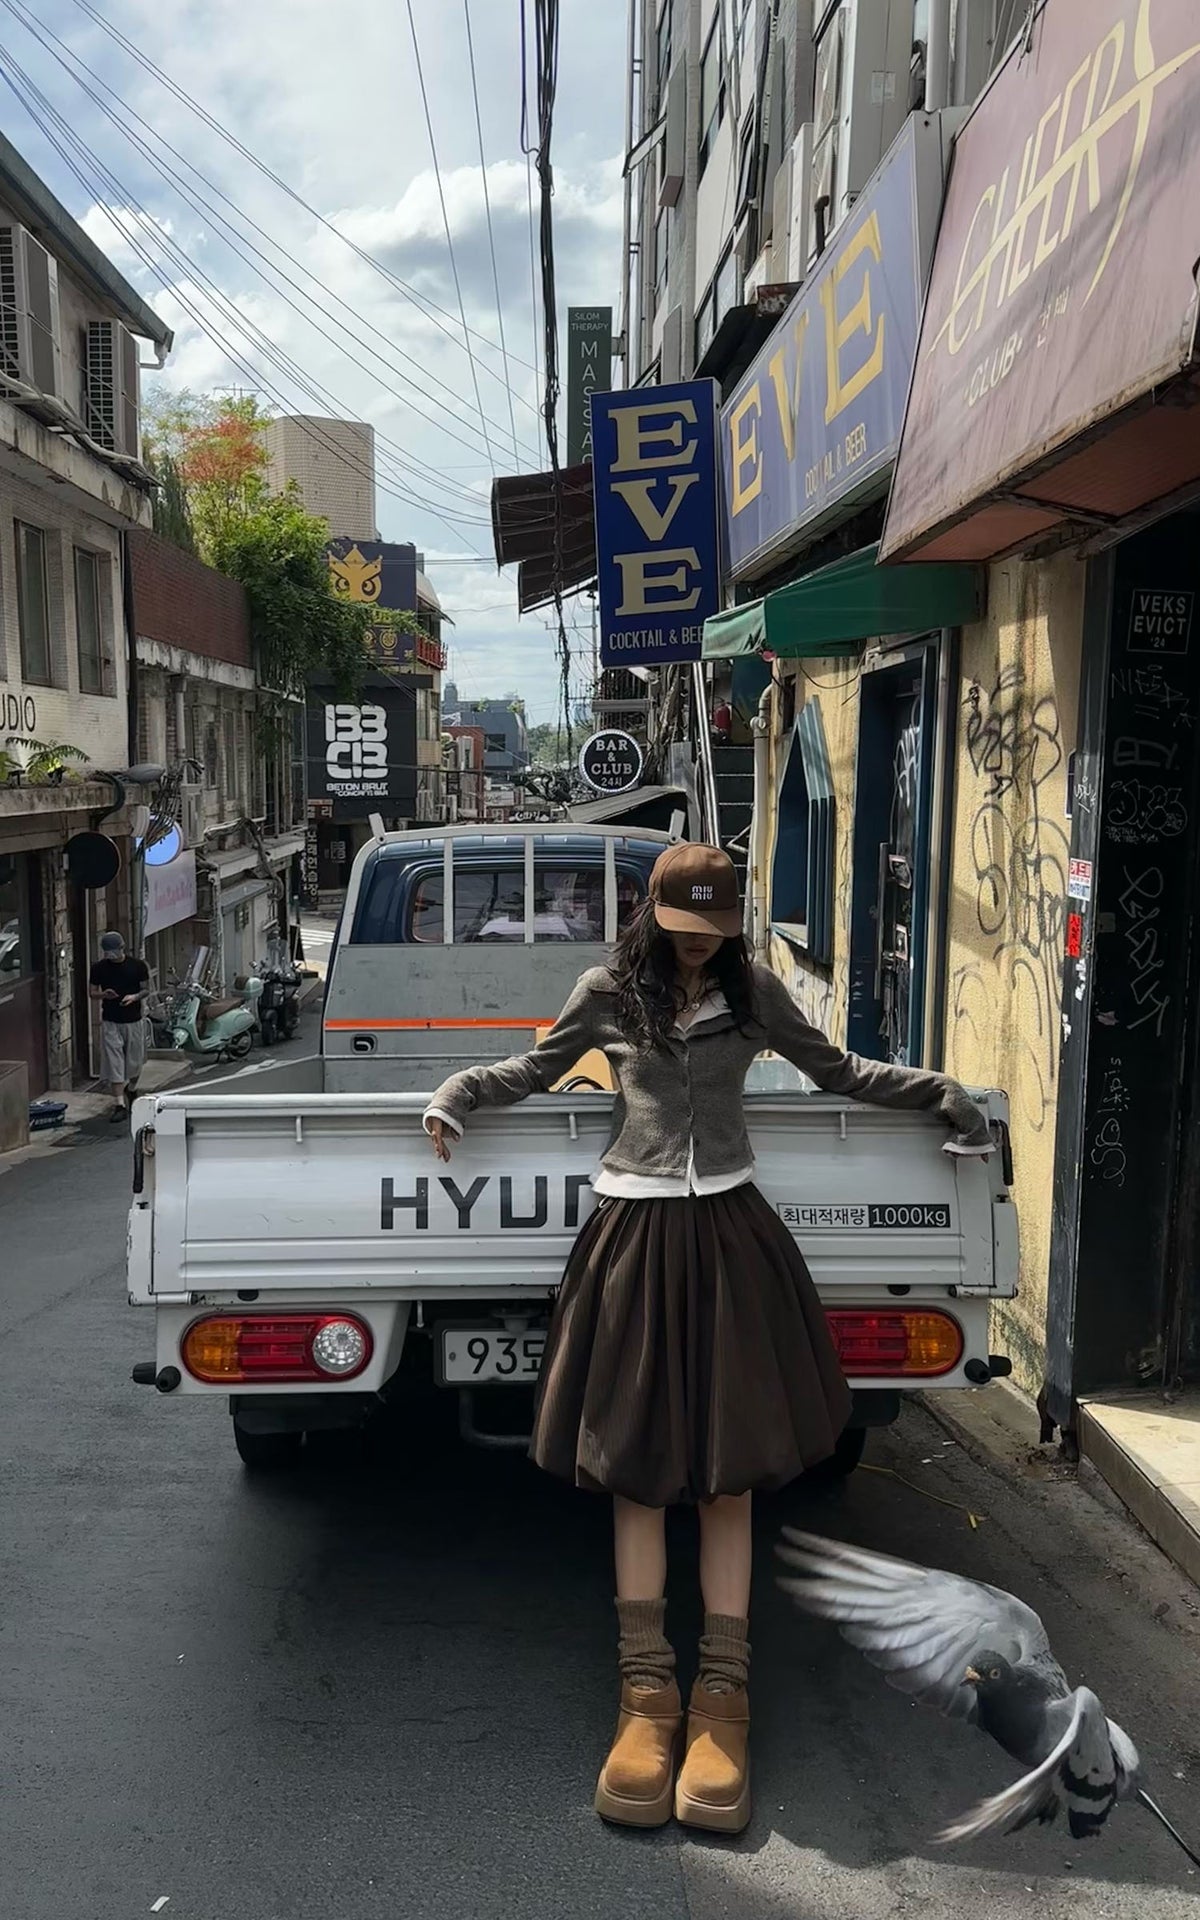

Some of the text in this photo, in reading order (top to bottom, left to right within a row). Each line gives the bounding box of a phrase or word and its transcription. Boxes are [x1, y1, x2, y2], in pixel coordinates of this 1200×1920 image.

[575, 312, 600, 321] SILOM
[571, 322, 609, 331] THERAPY
[729, 209, 885, 518] EVE
[845, 422, 867, 466] BEER
[608, 399, 702, 617] EVE
[1139, 594, 1187, 615] VEKS
[1133, 615, 1187, 635] EVICT
[609, 628, 667, 650] COCKTAIL
[669, 628, 679, 645] &
[1150, 636, 1166, 649] '24
[595, 738, 629, 751] BAR
[607, 751, 617, 762] &
[591, 762, 634, 775] CLUB
[601, 776, 623, 787] 24시
[783, 1206, 947, 1227] 최대적재량 1,000kg
